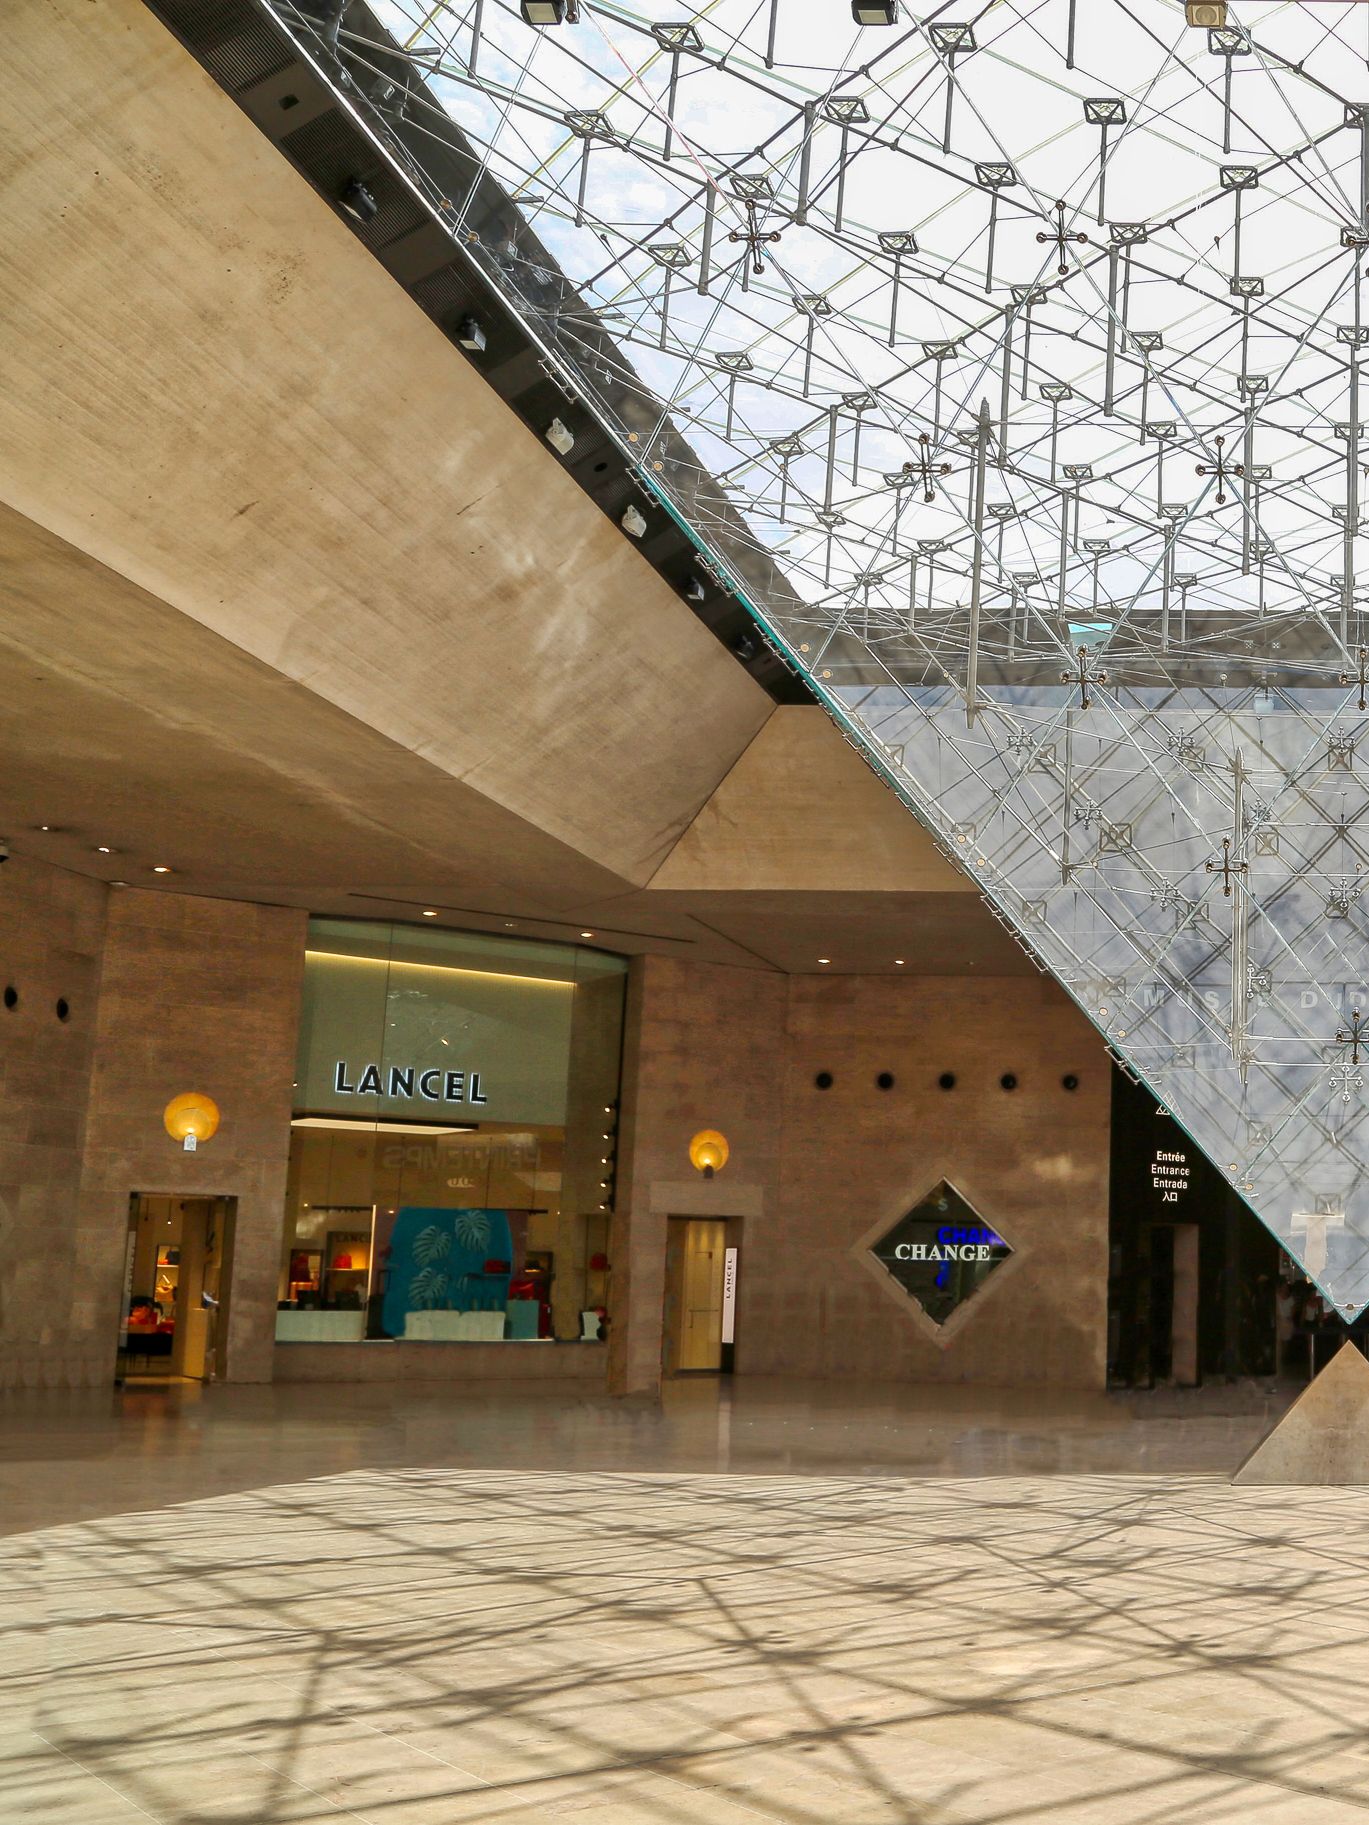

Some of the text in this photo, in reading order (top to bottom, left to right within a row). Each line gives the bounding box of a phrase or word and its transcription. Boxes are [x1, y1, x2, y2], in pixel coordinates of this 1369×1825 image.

[334, 1061, 488, 1104] LANCEL
[1156, 1150, 1186, 1163] Entrée
[1151, 1163, 1191, 1176] Entrance
[1153, 1177, 1188, 1190] Entrada
[1162, 1191, 1178, 1202] 入口
[894, 1243, 992, 1261] CHANGE
[725, 1258, 733, 1299] LANCEL
